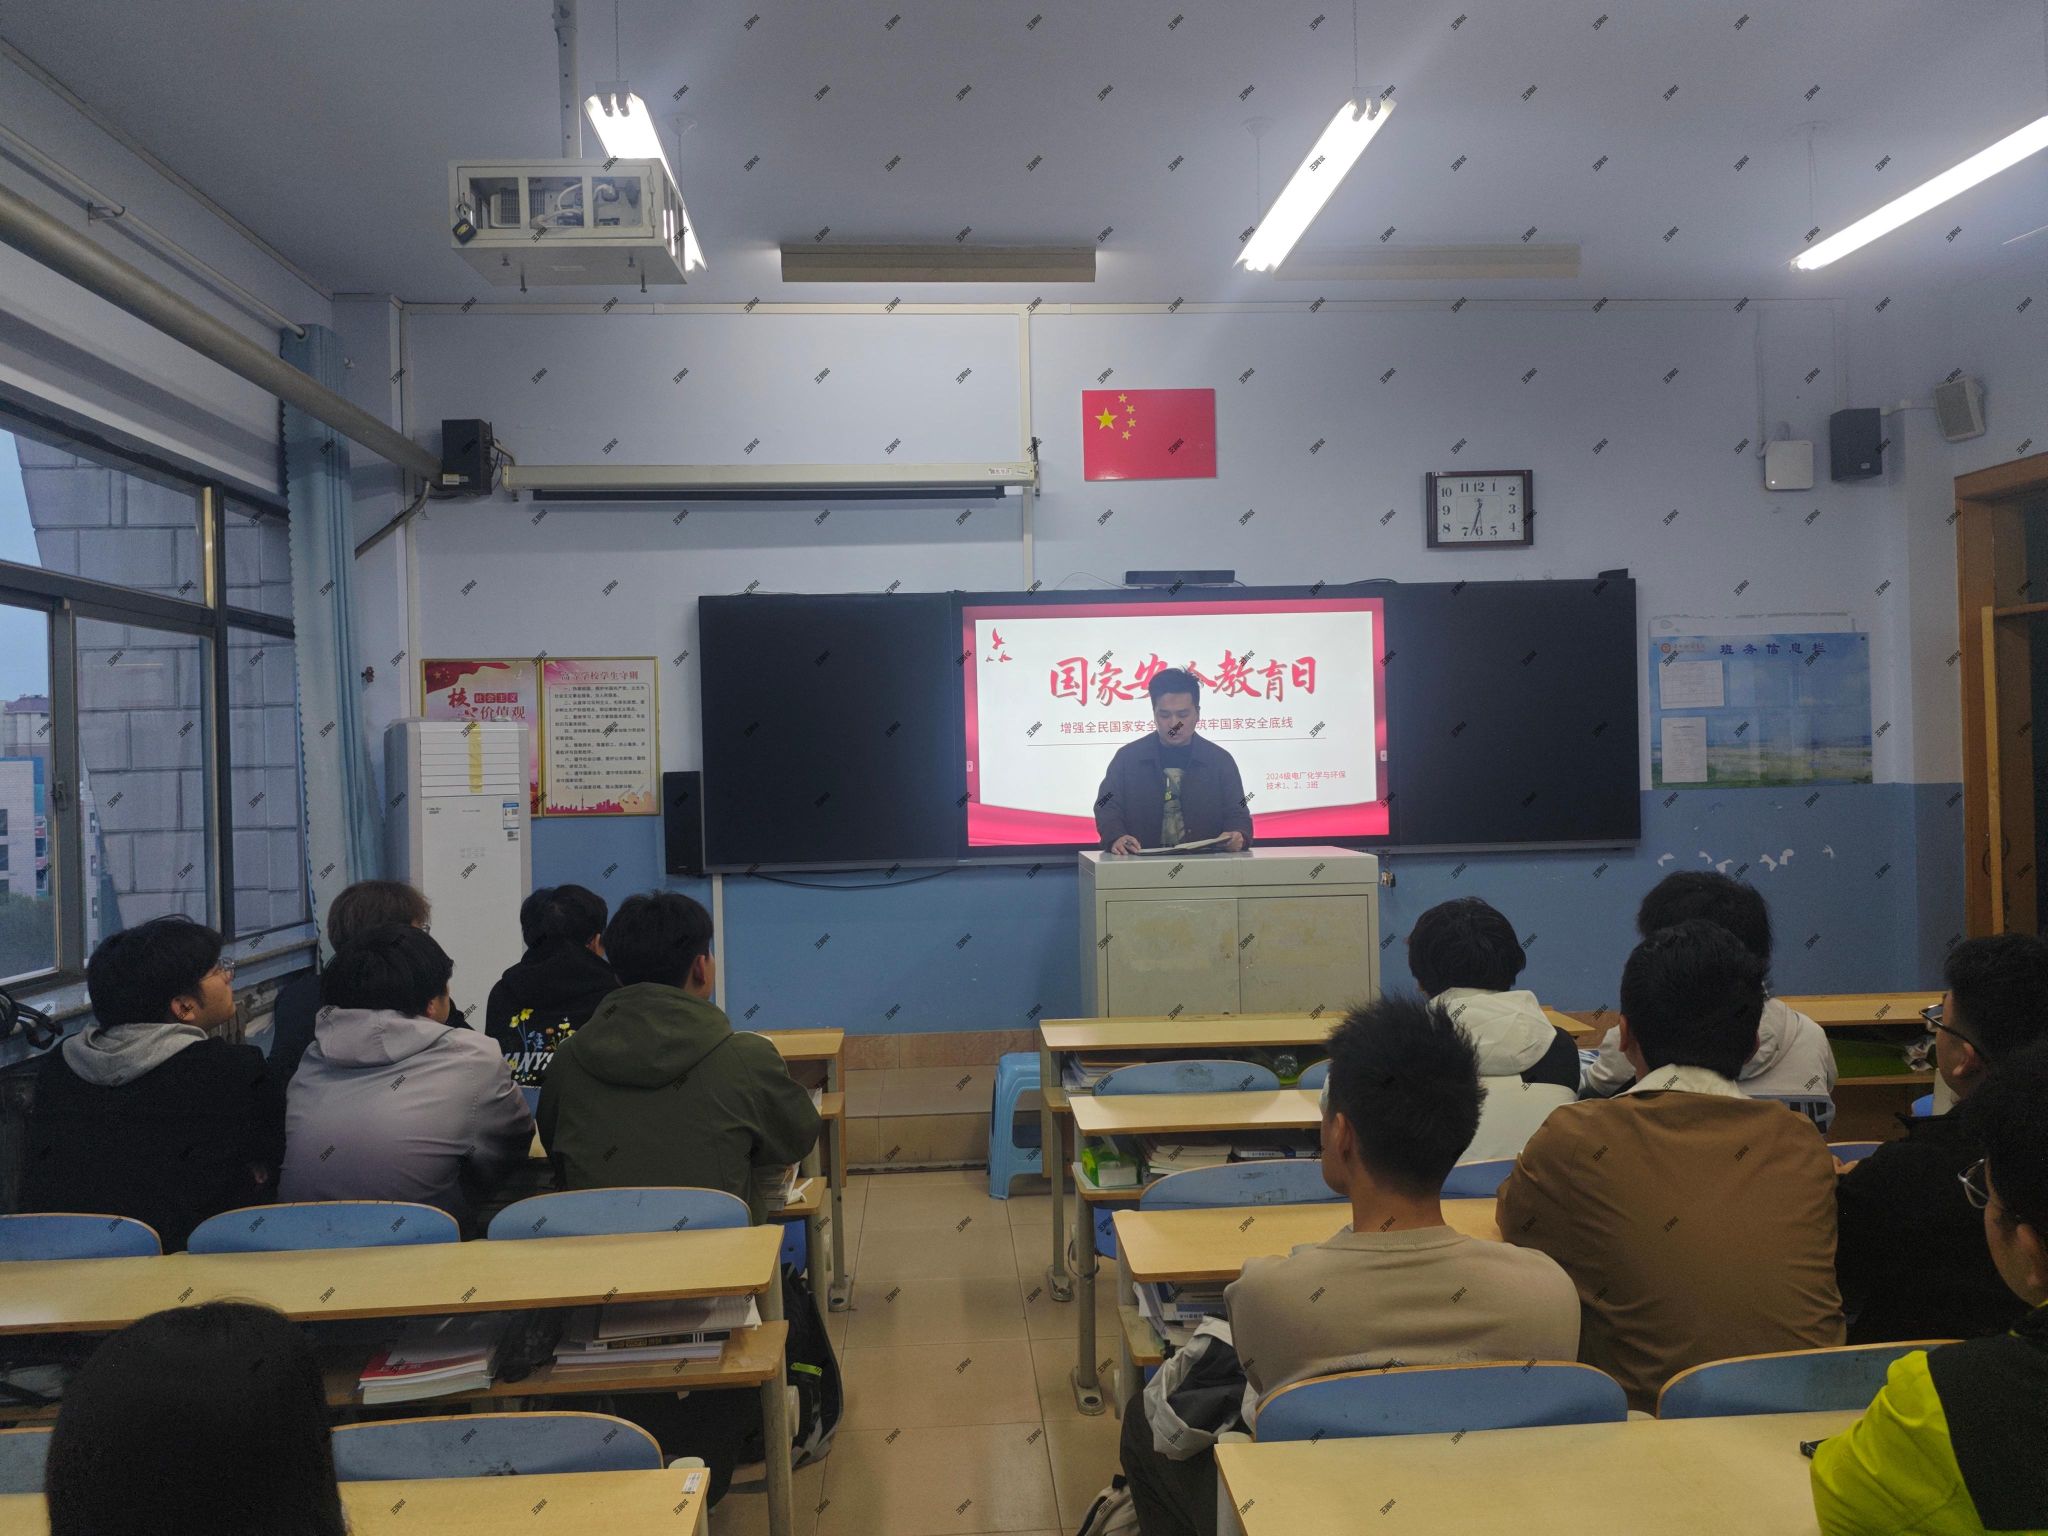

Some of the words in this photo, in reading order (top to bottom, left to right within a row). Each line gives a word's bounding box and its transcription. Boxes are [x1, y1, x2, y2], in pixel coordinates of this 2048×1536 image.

[1460, 482, 1469, 493] 11
[1473, 481, 1485, 493] 12
[1508, 486, 1516, 496] 2
[1441, 487, 1452, 498] 10
[1442, 505, 1451, 515] 9
[1508, 504, 1516, 514] 3
[1442, 523, 1451, 533] 8
[1462, 527, 1469, 537] 7
[1474, 526, 1483, 536] 6
[1490, 526, 1498, 536] 5
[1509, 522, 1516, 532] 4
[1719, 643, 1827, 655] 班务信息栏
[560, 671, 639, 681] 高等学校学生守则
[475, 693, 518, 703] 社会主义
[1266, 771, 1346, 780] 2024级电厂化学与环保
